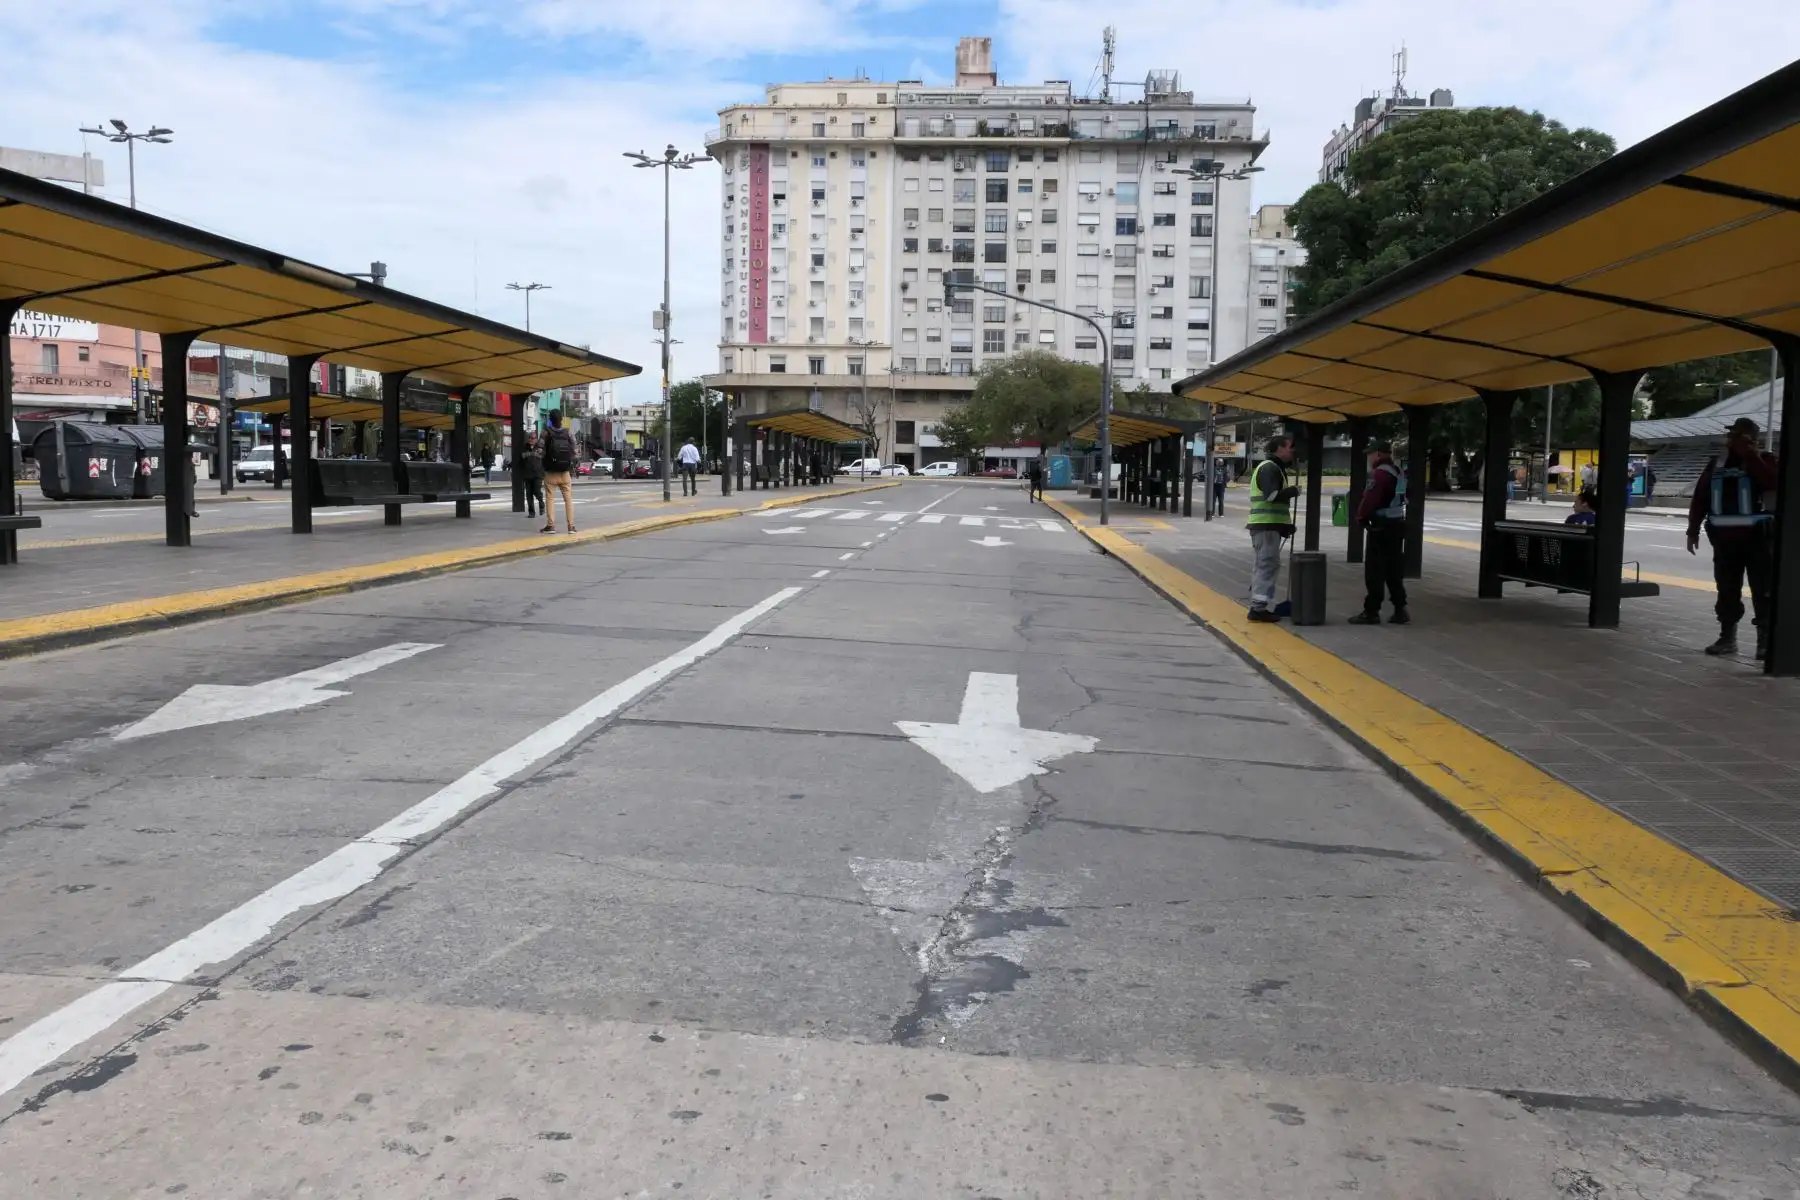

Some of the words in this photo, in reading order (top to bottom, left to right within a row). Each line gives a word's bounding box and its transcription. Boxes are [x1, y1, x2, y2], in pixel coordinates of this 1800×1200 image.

[752, 238, 764, 330] HOTEL
[26, 376, 63, 386] TREN
[68, 378, 112, 388] MIXTO
